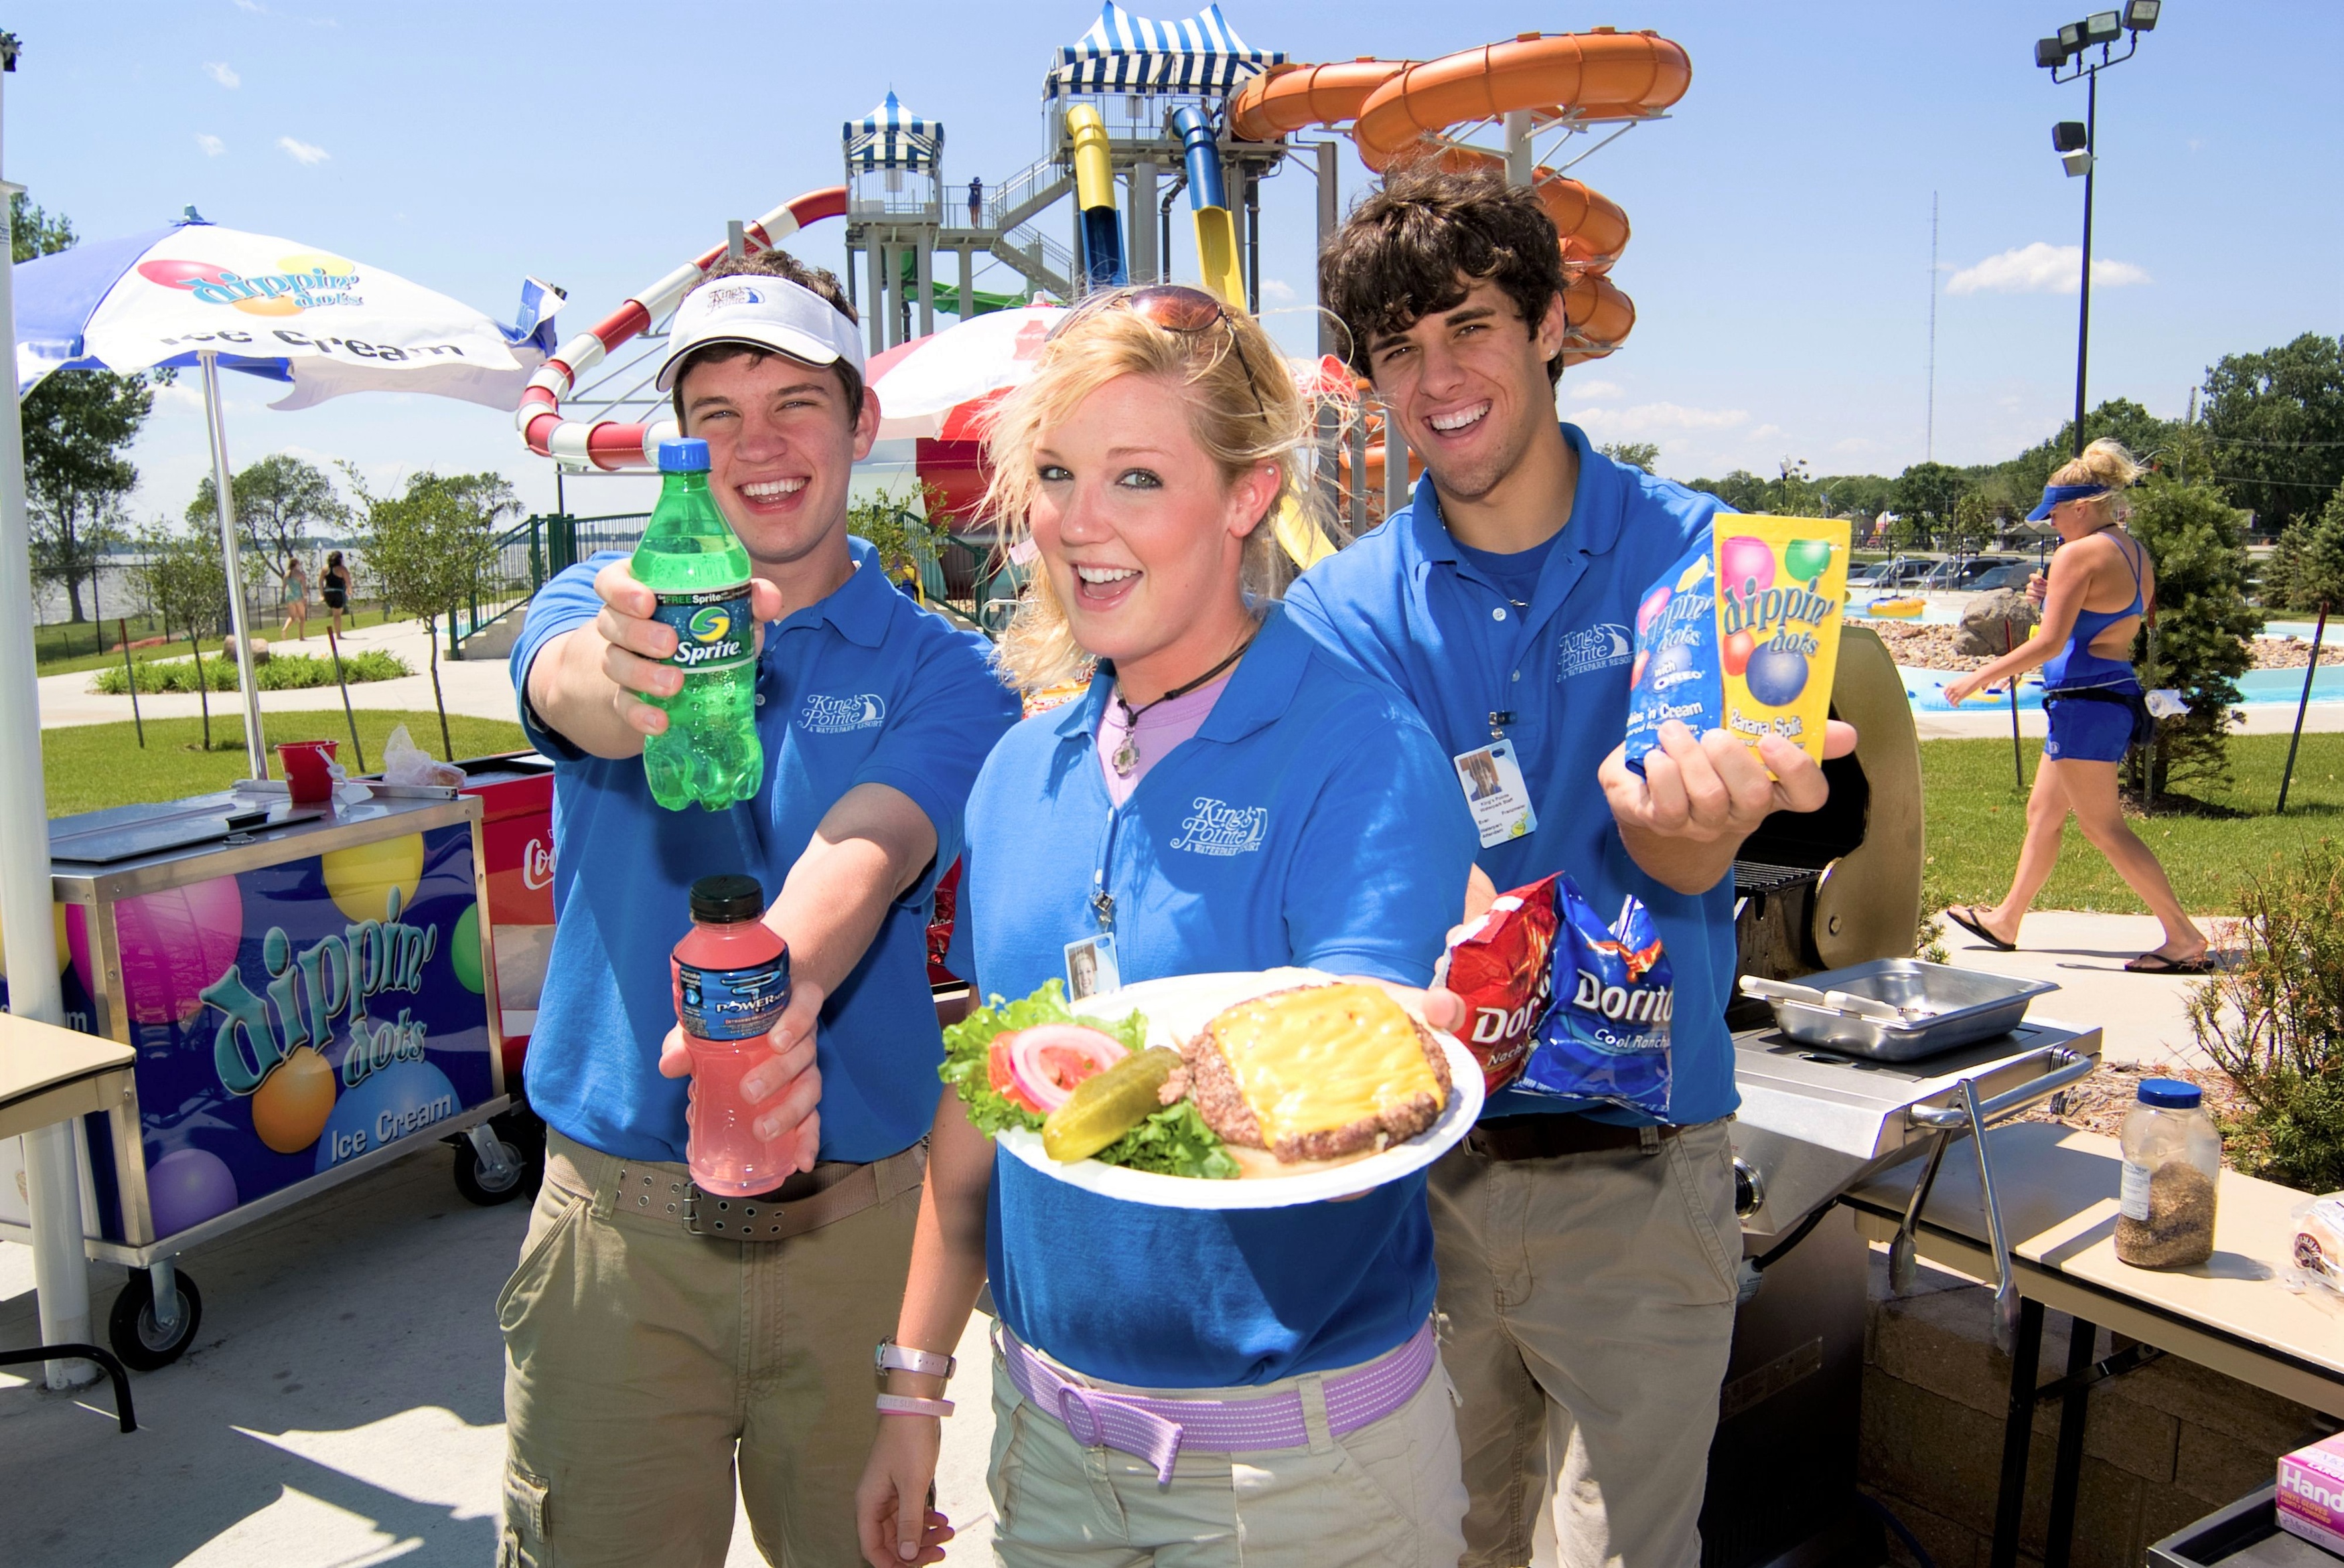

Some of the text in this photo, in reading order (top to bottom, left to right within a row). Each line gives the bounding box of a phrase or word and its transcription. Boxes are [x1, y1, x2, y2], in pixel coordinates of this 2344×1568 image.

[177, 268, 359, 304] dippin'
[293, 292, 364, 308] dots
[666, 595, 692, 604] FREE
[692, 593, 722, 605] Sprite
[1723, 576, 1835, 637] dippin'
[674, 640, 741, 665] Sprite
[1559, 624, 1605, 653] King's
[1657, 625, 1702, 654] dots
[1768, 627, 1820, 657] dots
[1654, 660, 1676, 678] with
[1654, 670, 1702, 691] OREO
[798, 708, 860, 729] Pointe
[807, 694, 863, 715] King's
[1660, 702, 1704, 719] Cream
[1731, 707, 1803, 740] Banana Split
[1193, 797, 1256, 831] King's
[1170, 817, 1248, 849] Pointe
[199, 885, 437, 1096] dippin'
[1572, 968, 1673, 1022] Dorito
[342, 1007, 427, 1088] dots
[1595, 1028, 1631, 1048] Cool
[1487, 1042, 1526, 1067] Nach
[332, 1093, 452, 1163] Ice Cream
[2301, 1499, 2329, 1516] GLOVES
